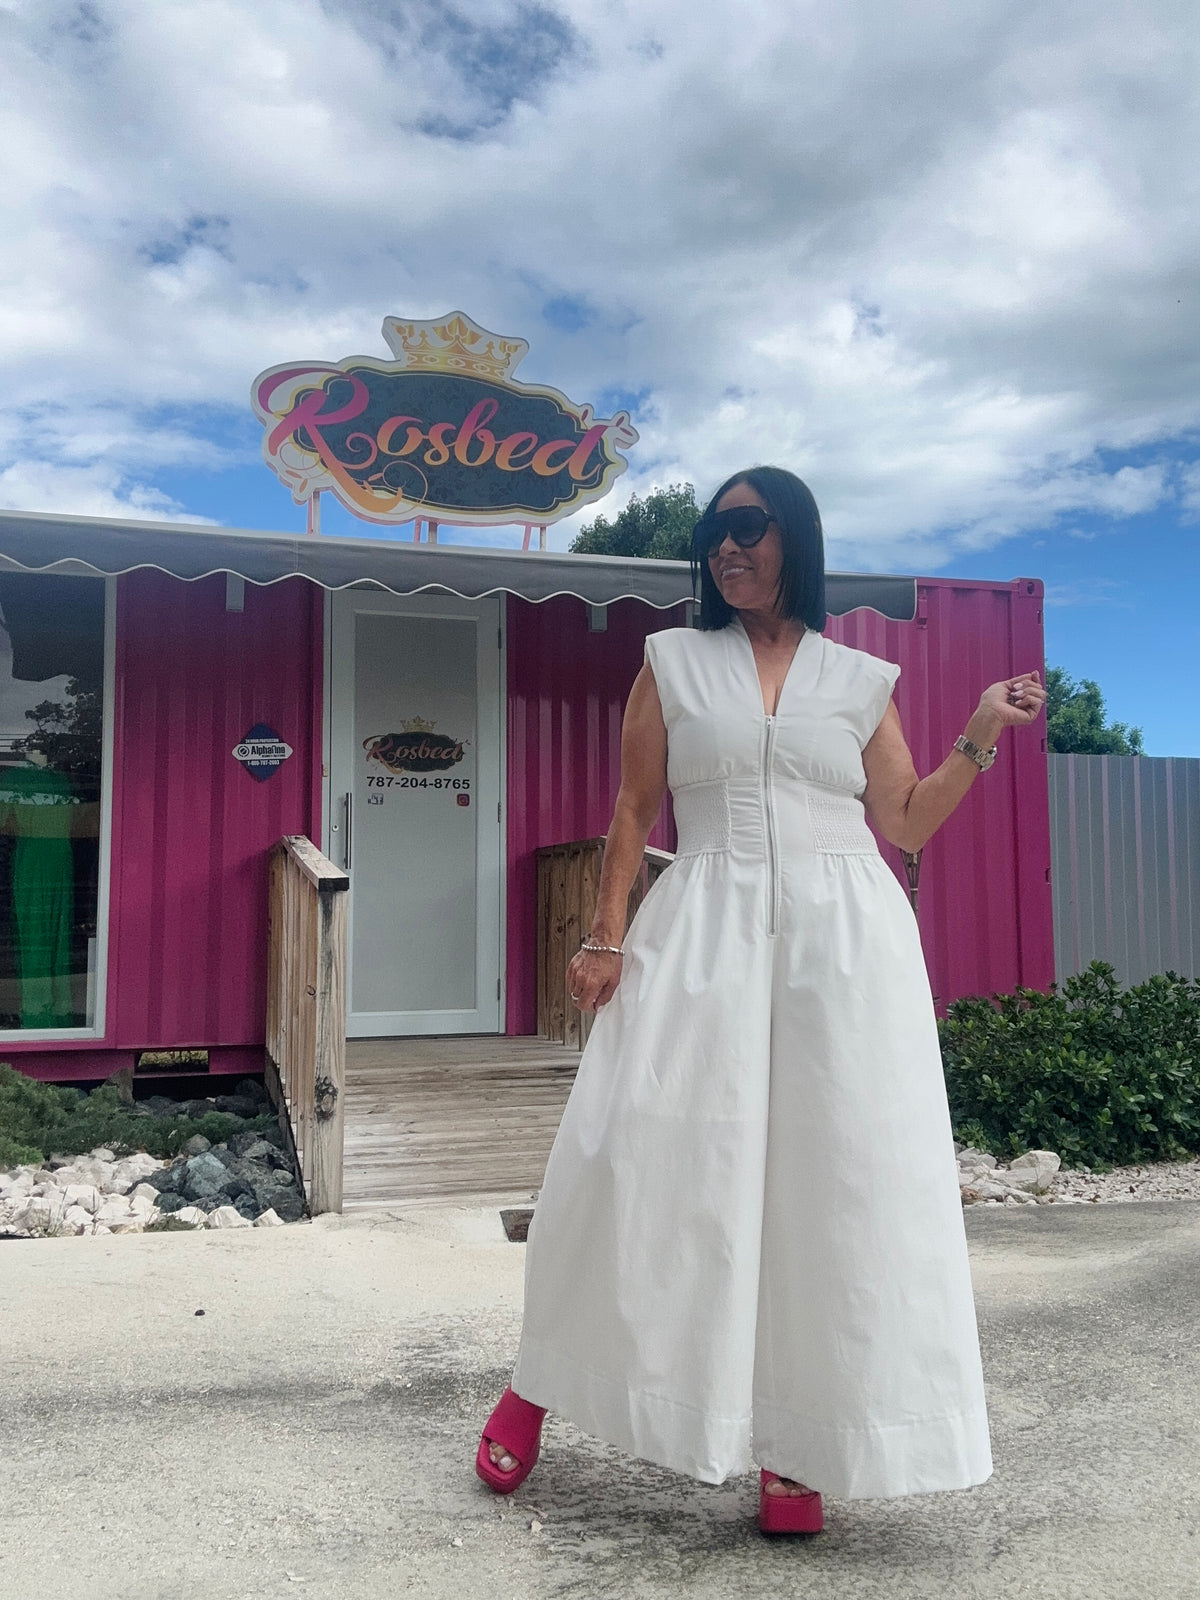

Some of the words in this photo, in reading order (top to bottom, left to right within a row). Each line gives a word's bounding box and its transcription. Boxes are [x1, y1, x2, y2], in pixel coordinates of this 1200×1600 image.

[257, 366, 609, 514] Rosbed
[363, 734, 464, 774] Rosbed
[366, 776, 470, 789] 787-204-8765
